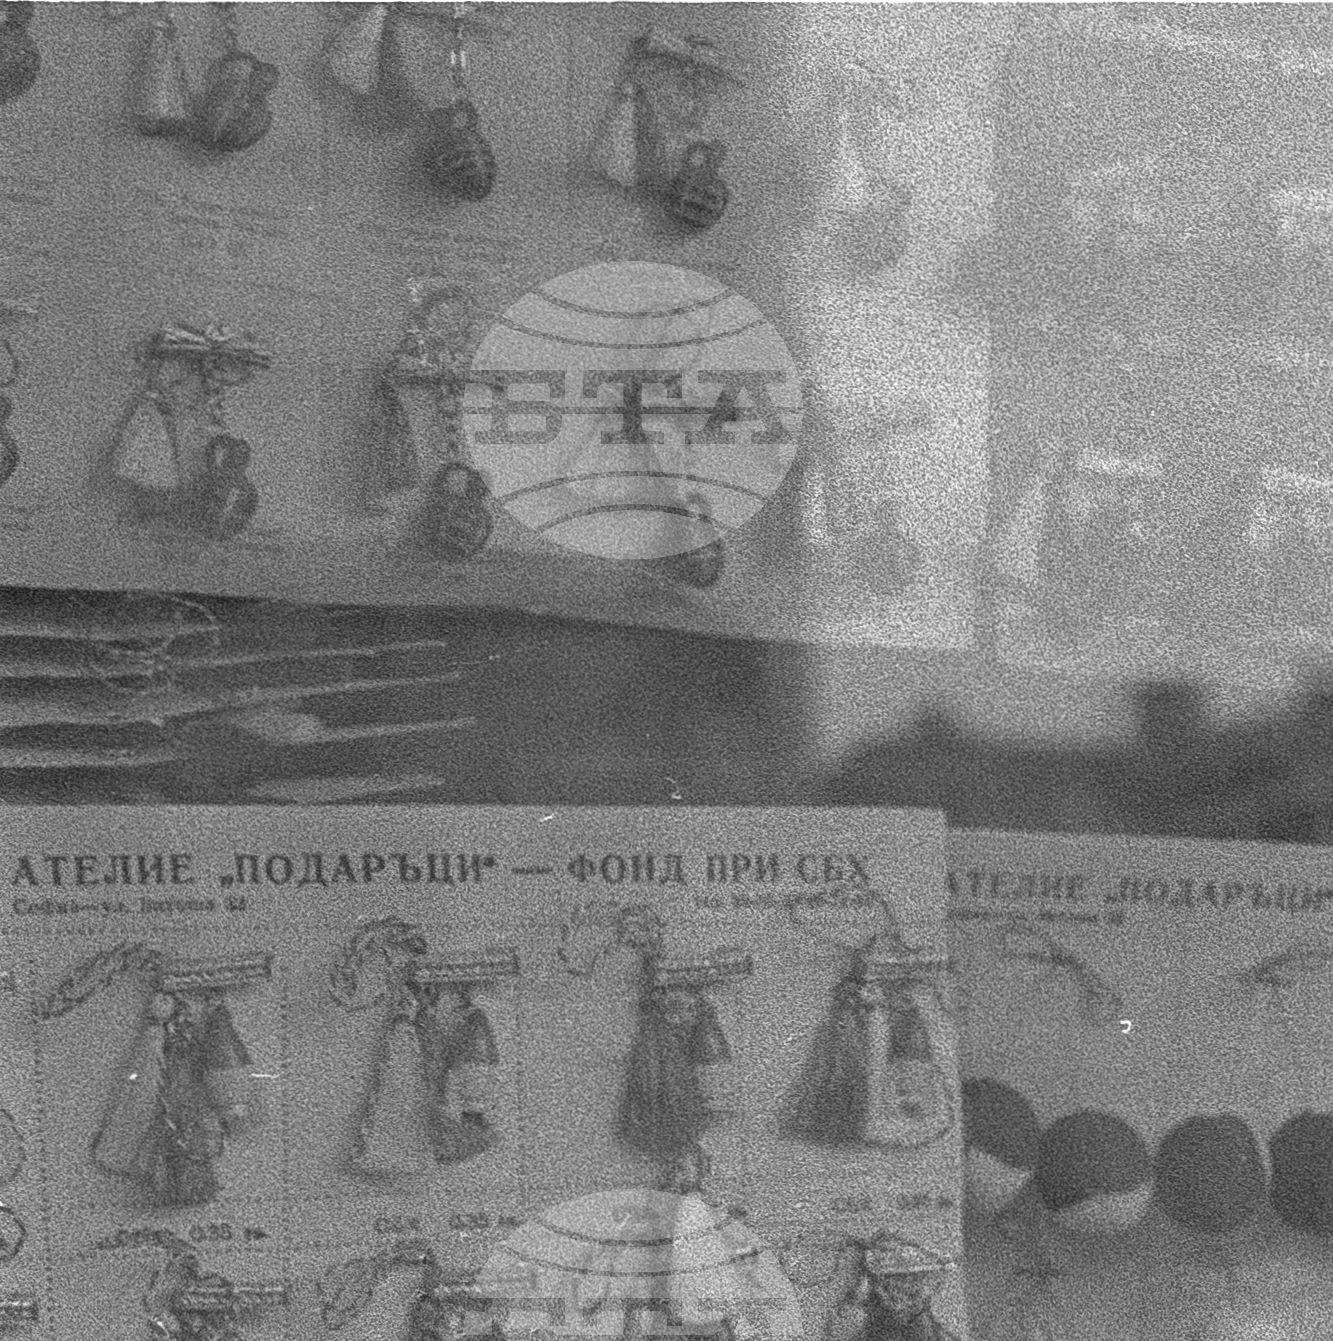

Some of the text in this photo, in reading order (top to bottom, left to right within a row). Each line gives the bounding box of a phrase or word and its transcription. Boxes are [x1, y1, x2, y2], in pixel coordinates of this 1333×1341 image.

[12, 853, 196, 887] АТЕЛИЕ
[568, 852, 688, 886] ФОНД
[705, 852, 782, 885] ПРИ
[796, 852, 872, 885] СБХ
